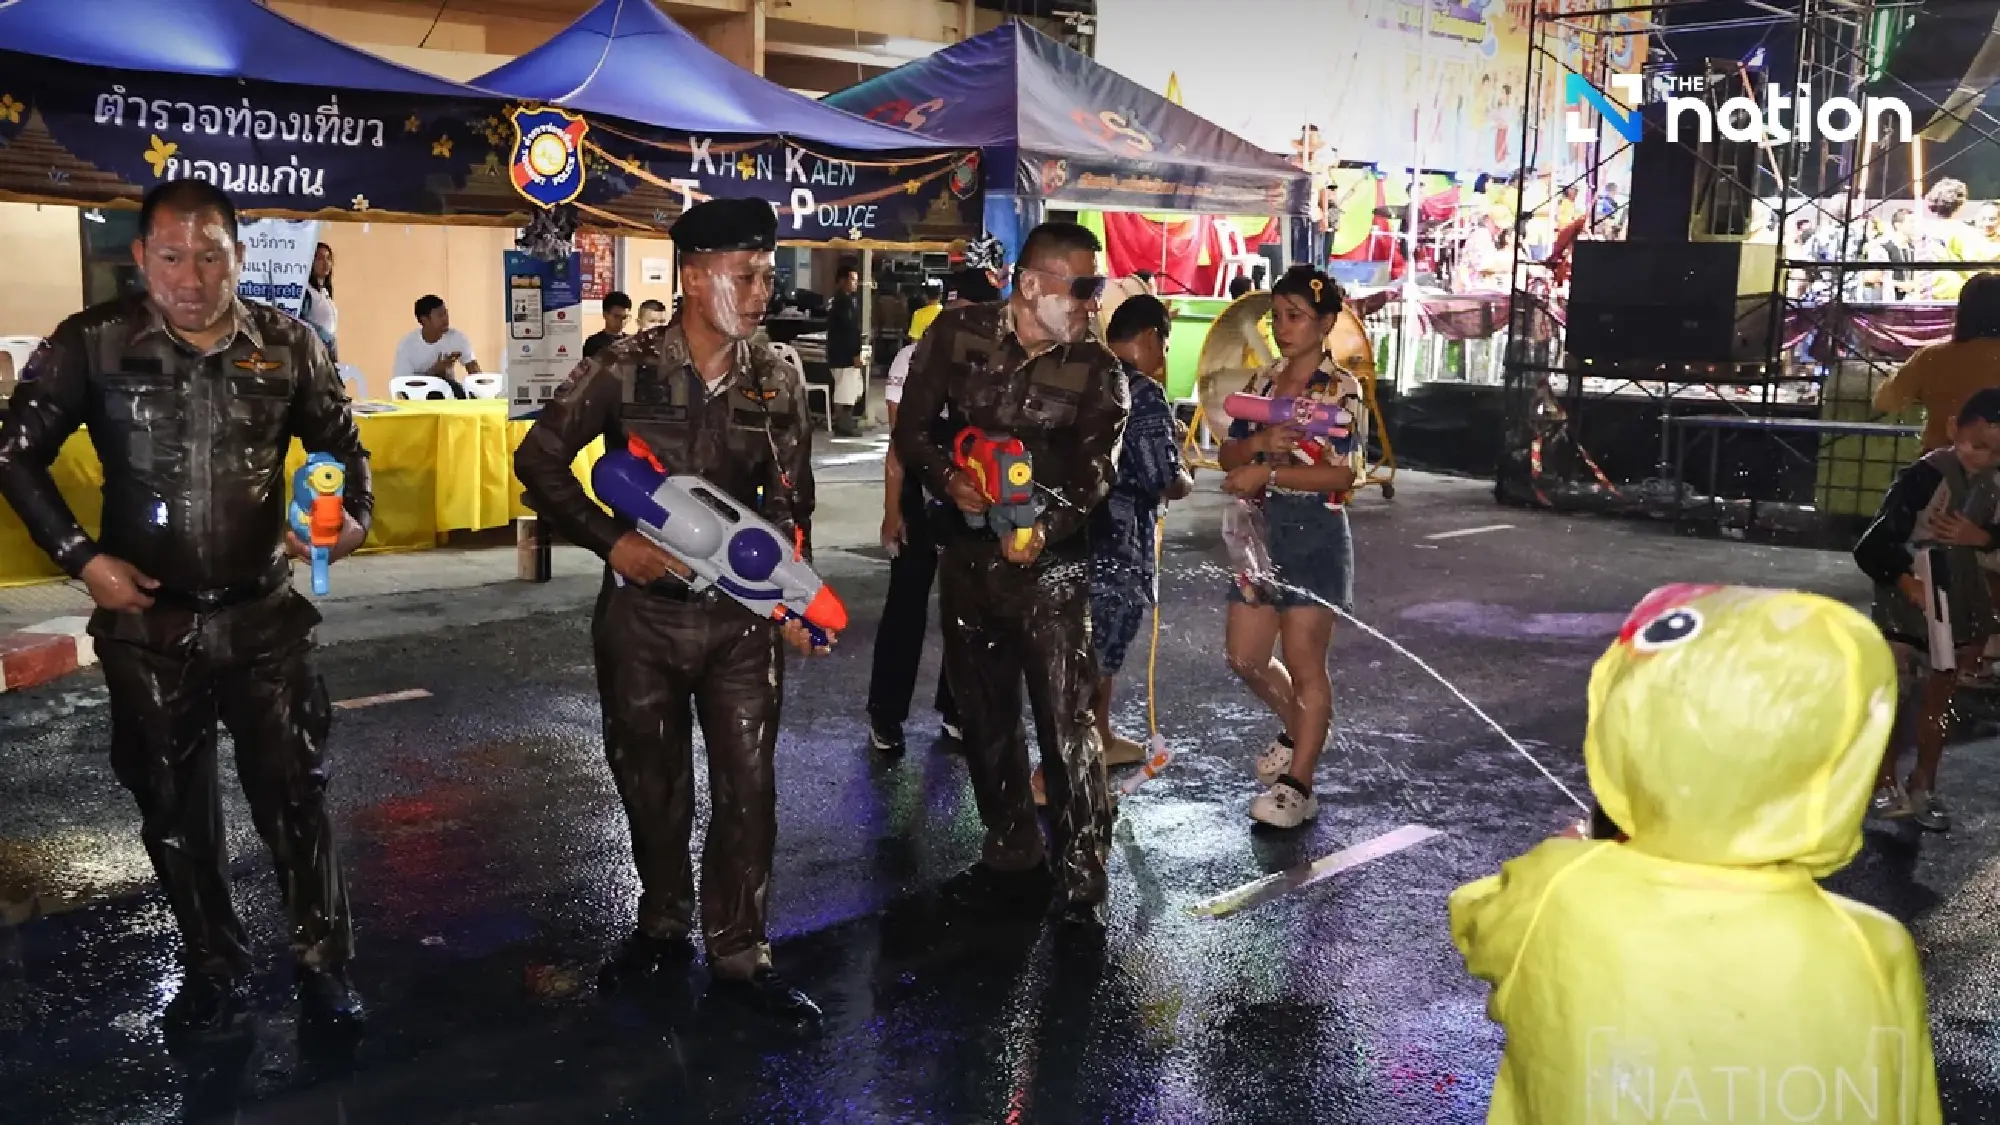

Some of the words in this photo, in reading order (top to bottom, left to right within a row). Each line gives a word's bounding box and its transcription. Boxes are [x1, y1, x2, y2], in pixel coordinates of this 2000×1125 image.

[94, 84, 384, 147] ตำรวจท่องเที่ยว
[689, 136, 773, 182] KHN
[785, 147, 856, 187] KAEN
[790, 187, 879, 230] POLICE
[248, 231, 296, 250] บริการ
